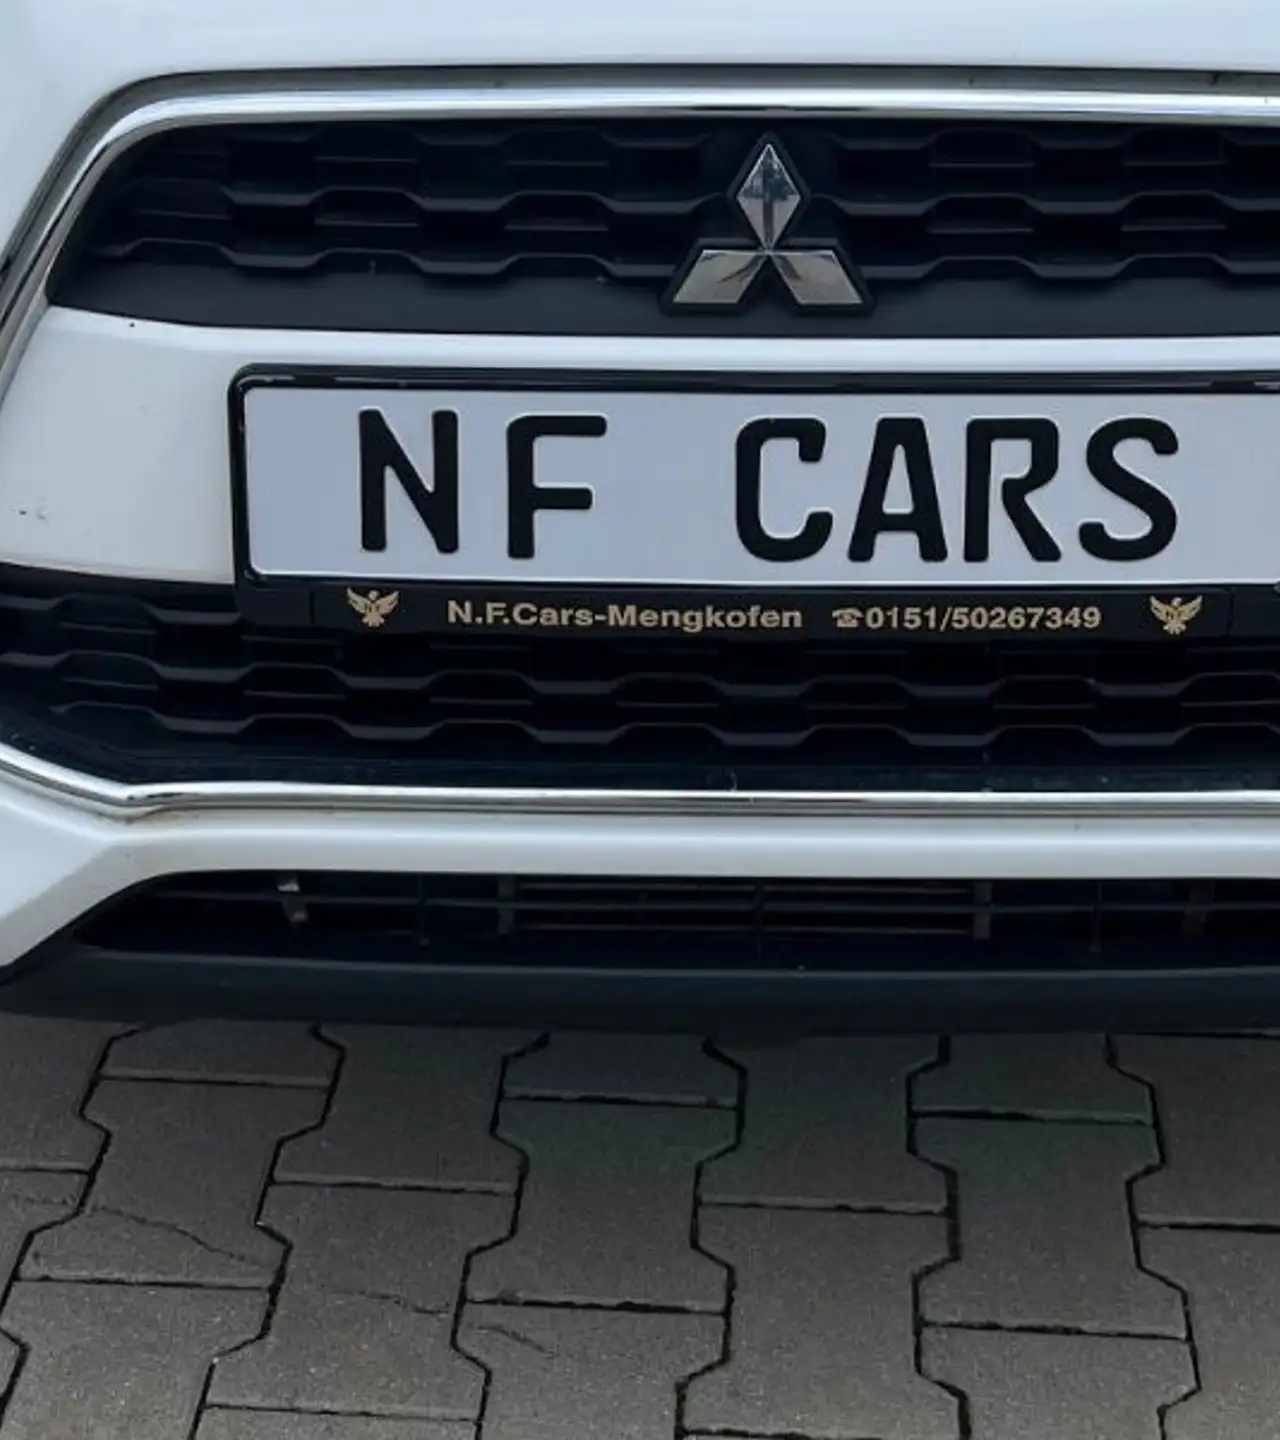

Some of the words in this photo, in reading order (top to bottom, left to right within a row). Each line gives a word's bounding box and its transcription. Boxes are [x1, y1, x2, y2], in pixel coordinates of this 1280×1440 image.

[734, 417, 1180, 563] CARS
[447, 600, 802, 633] N.F.Cars-Mengkofen
[866, 606, 1102, 632] 0151/50267349
